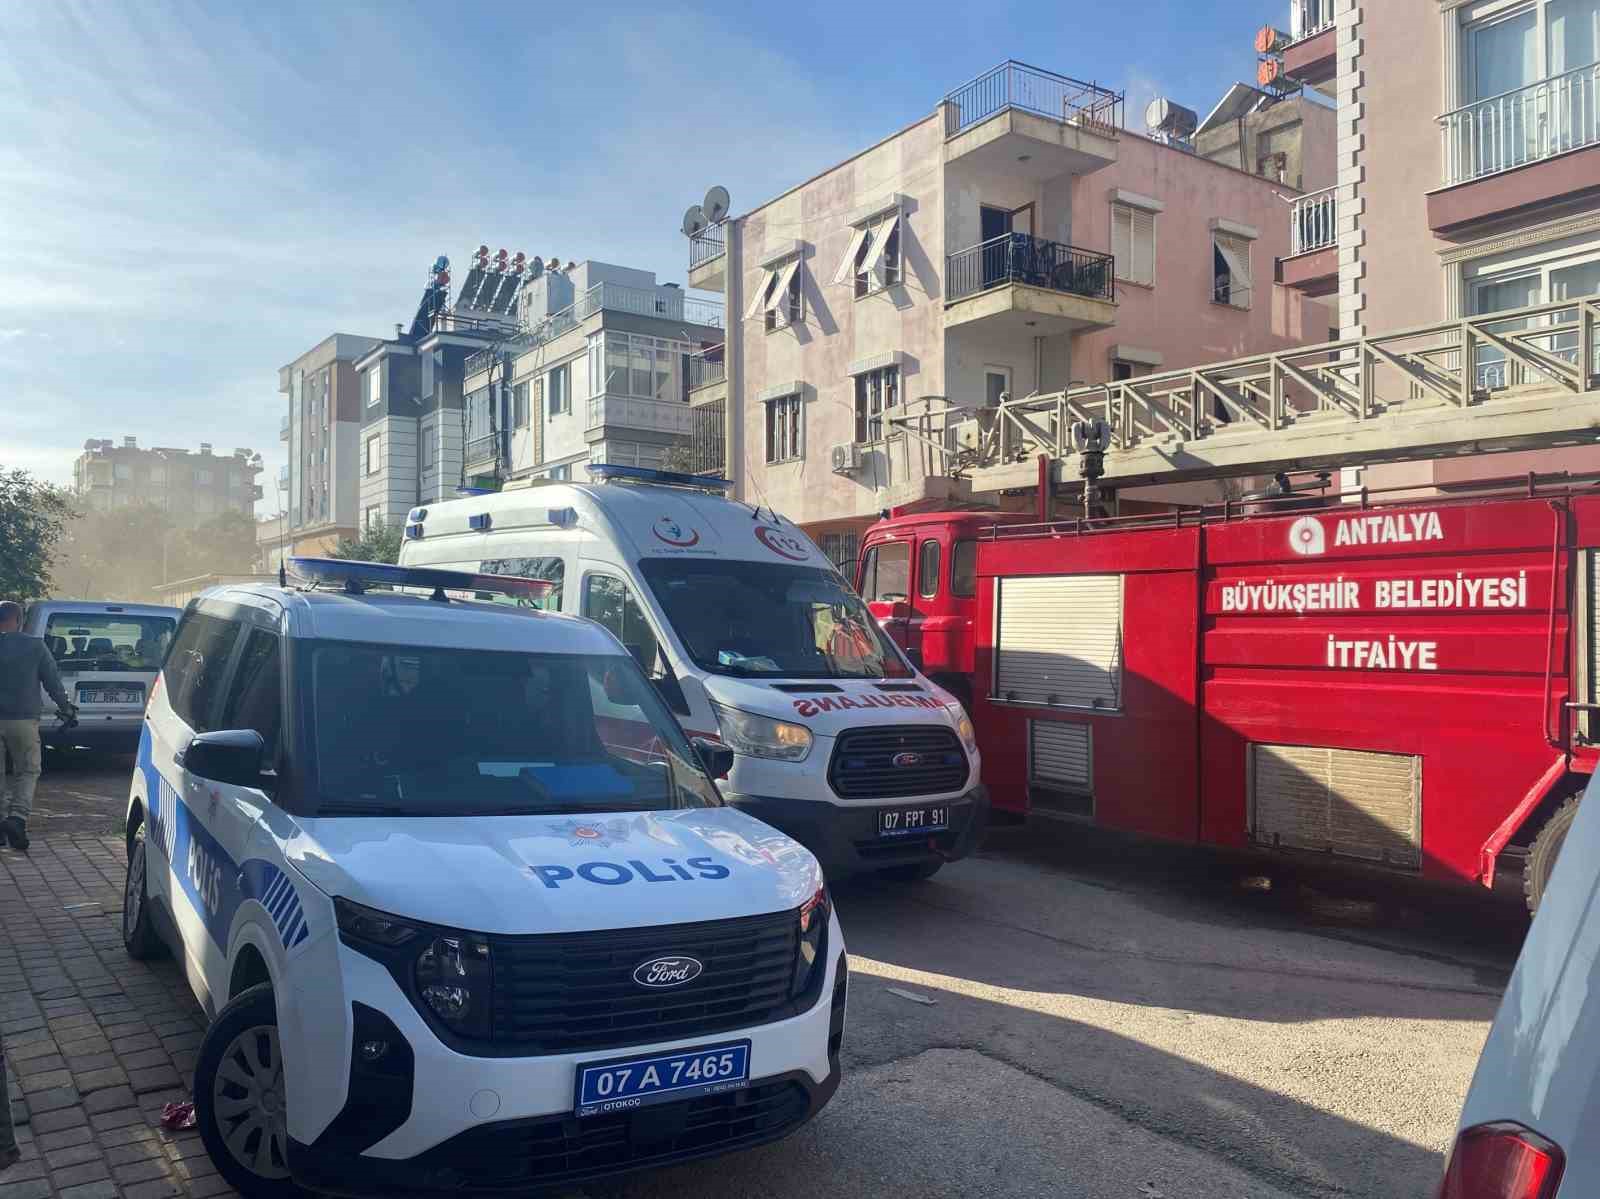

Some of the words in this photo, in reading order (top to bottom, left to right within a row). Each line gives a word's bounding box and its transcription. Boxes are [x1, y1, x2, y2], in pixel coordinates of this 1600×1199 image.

[768, 535, 807, 553] 112
[1335, 511, 1443, 546] ANTALYA
[1222, 576, 1360, 615] BÜYÜKŞEHİR
[1375, 570, 1527, 608] BELEDİYESİ
[1327, 634, 1438, 670] İTFAİYE
[884, 812, 899, 829] 07
[905, 811, 925, 828] FPT
[932, 808, 944, 824] 91
[647, 961, 689, 983] Ford
[597, 1069, 632, 1096] 07
[638, 1065, 661, 1089] A
[670, 1053, 734, 1084] 7465
